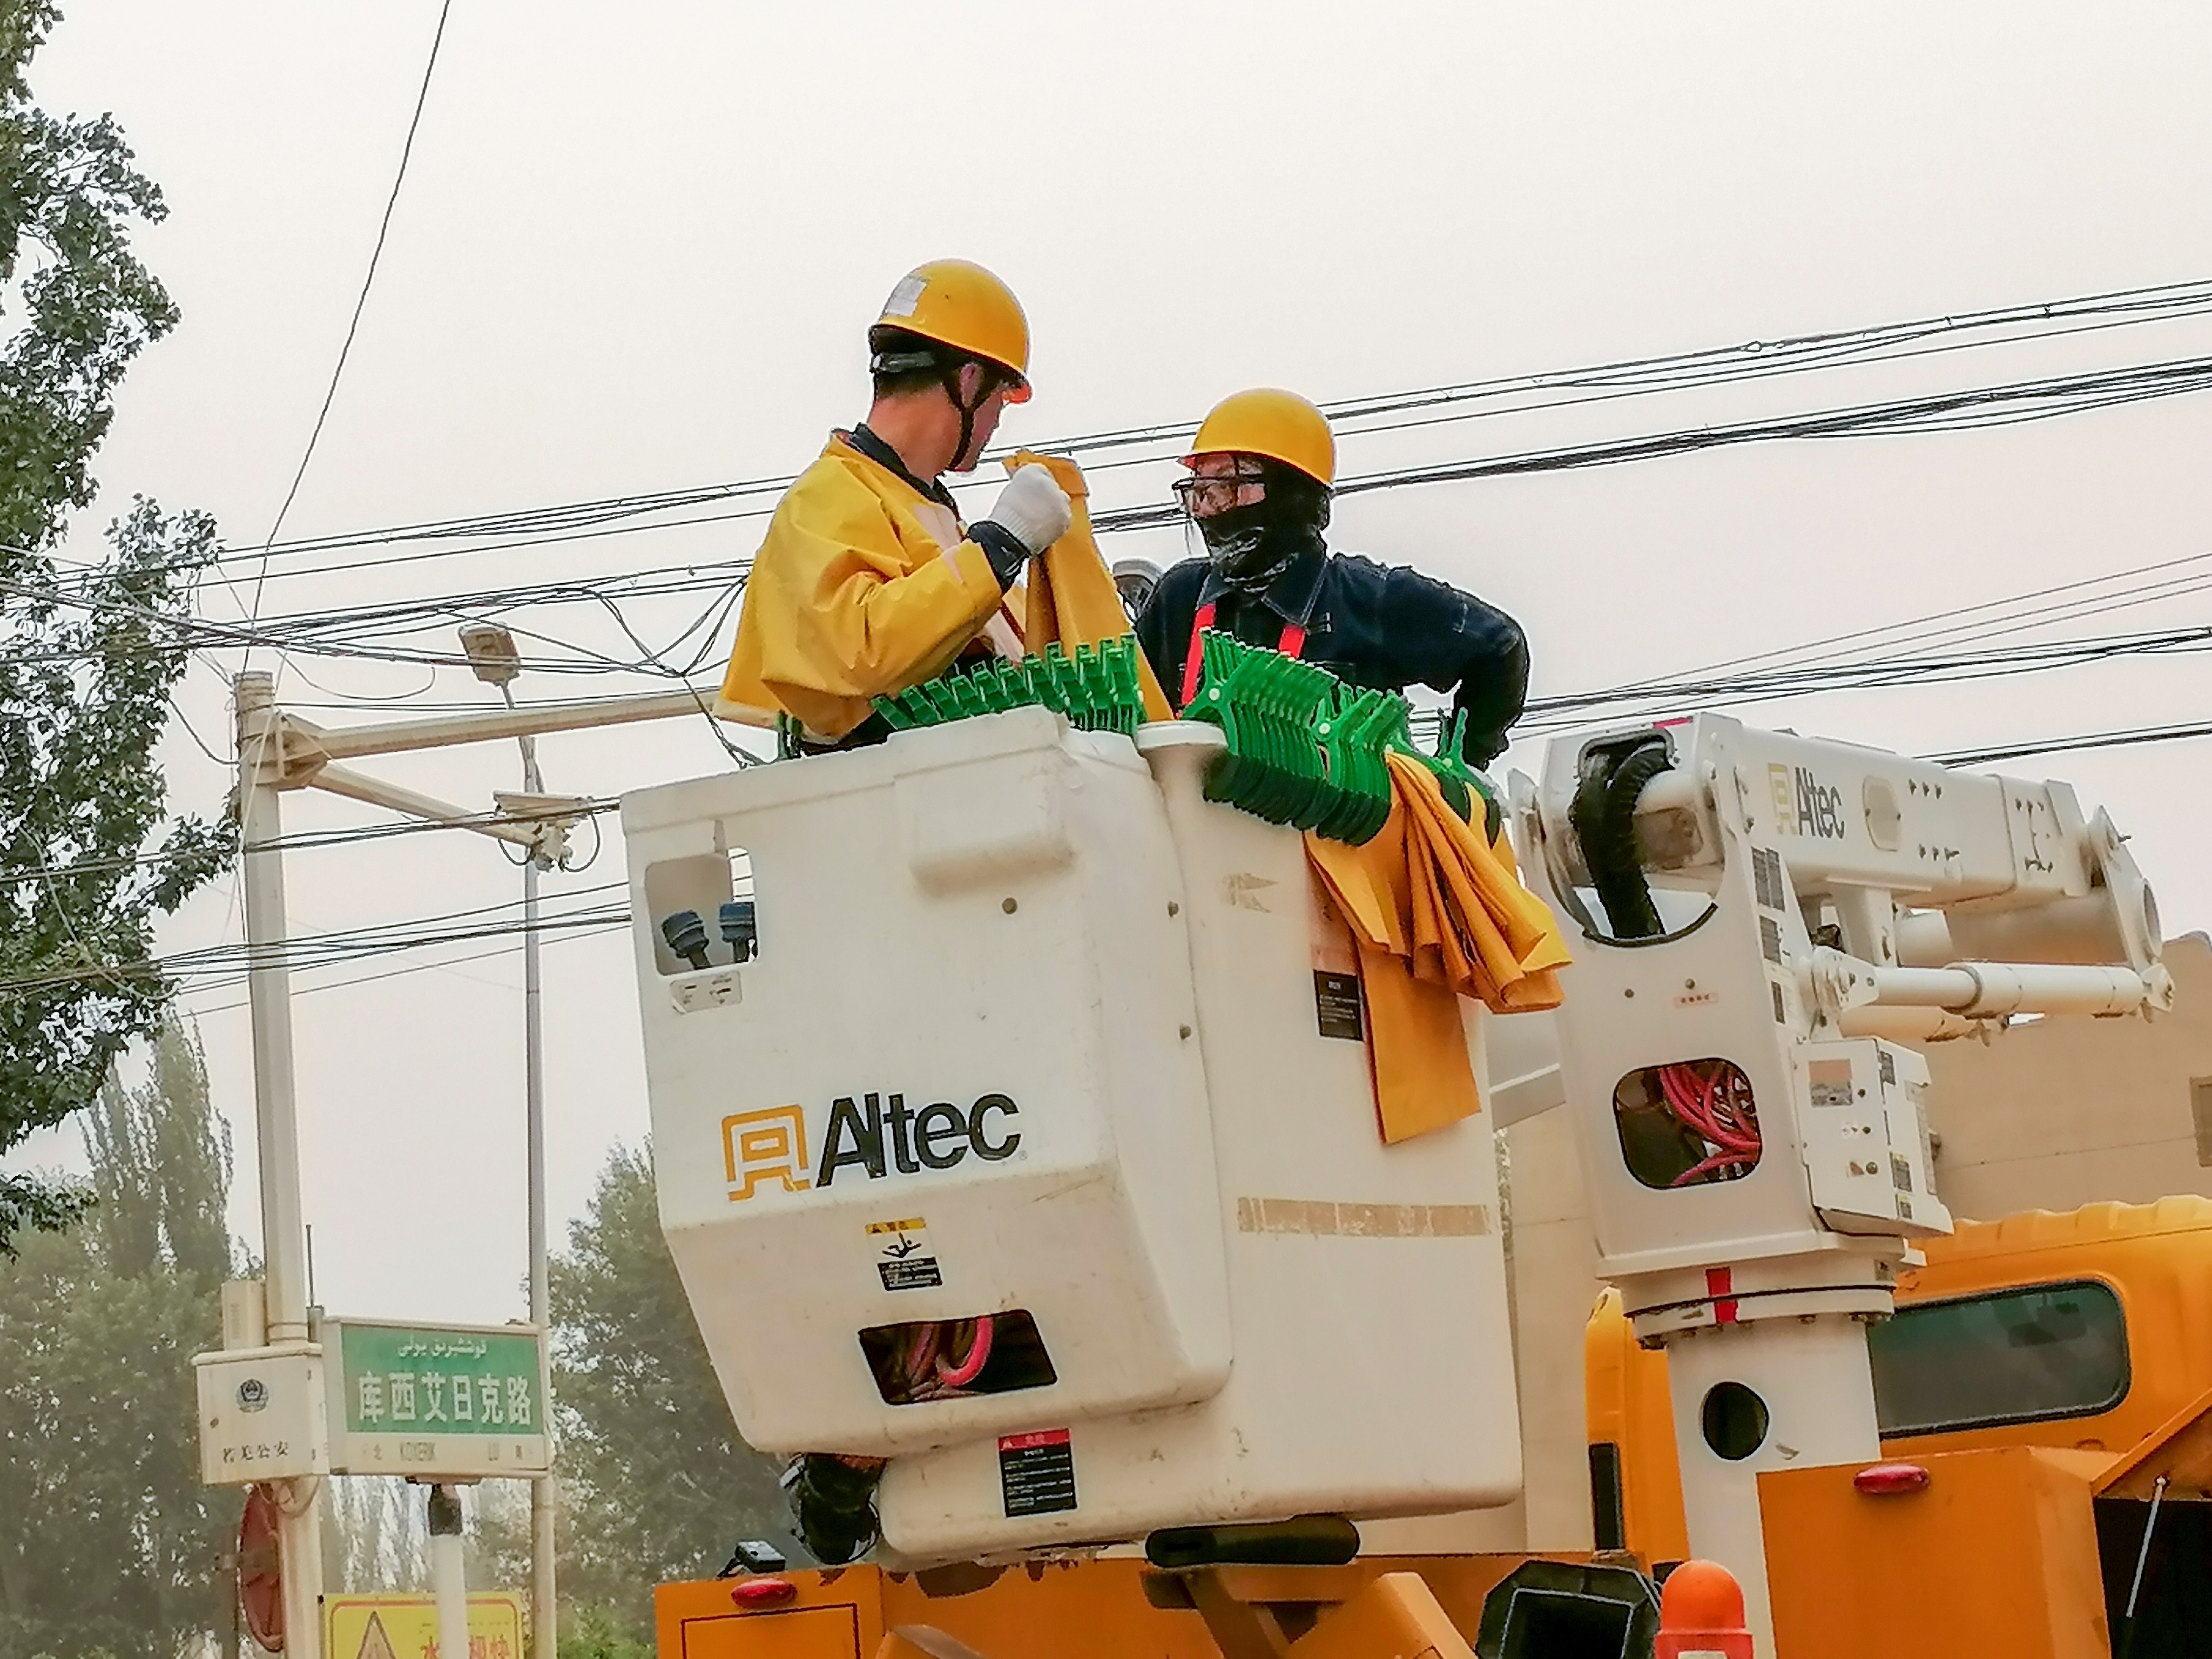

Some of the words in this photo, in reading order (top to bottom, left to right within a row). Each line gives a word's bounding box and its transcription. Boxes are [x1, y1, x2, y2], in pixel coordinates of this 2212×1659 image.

[1795, 767, 1845, 839] Altec
[816, 1092, 1021, 1188] Altec
[359, 1370, 531, 1426] 库西艾日克路
